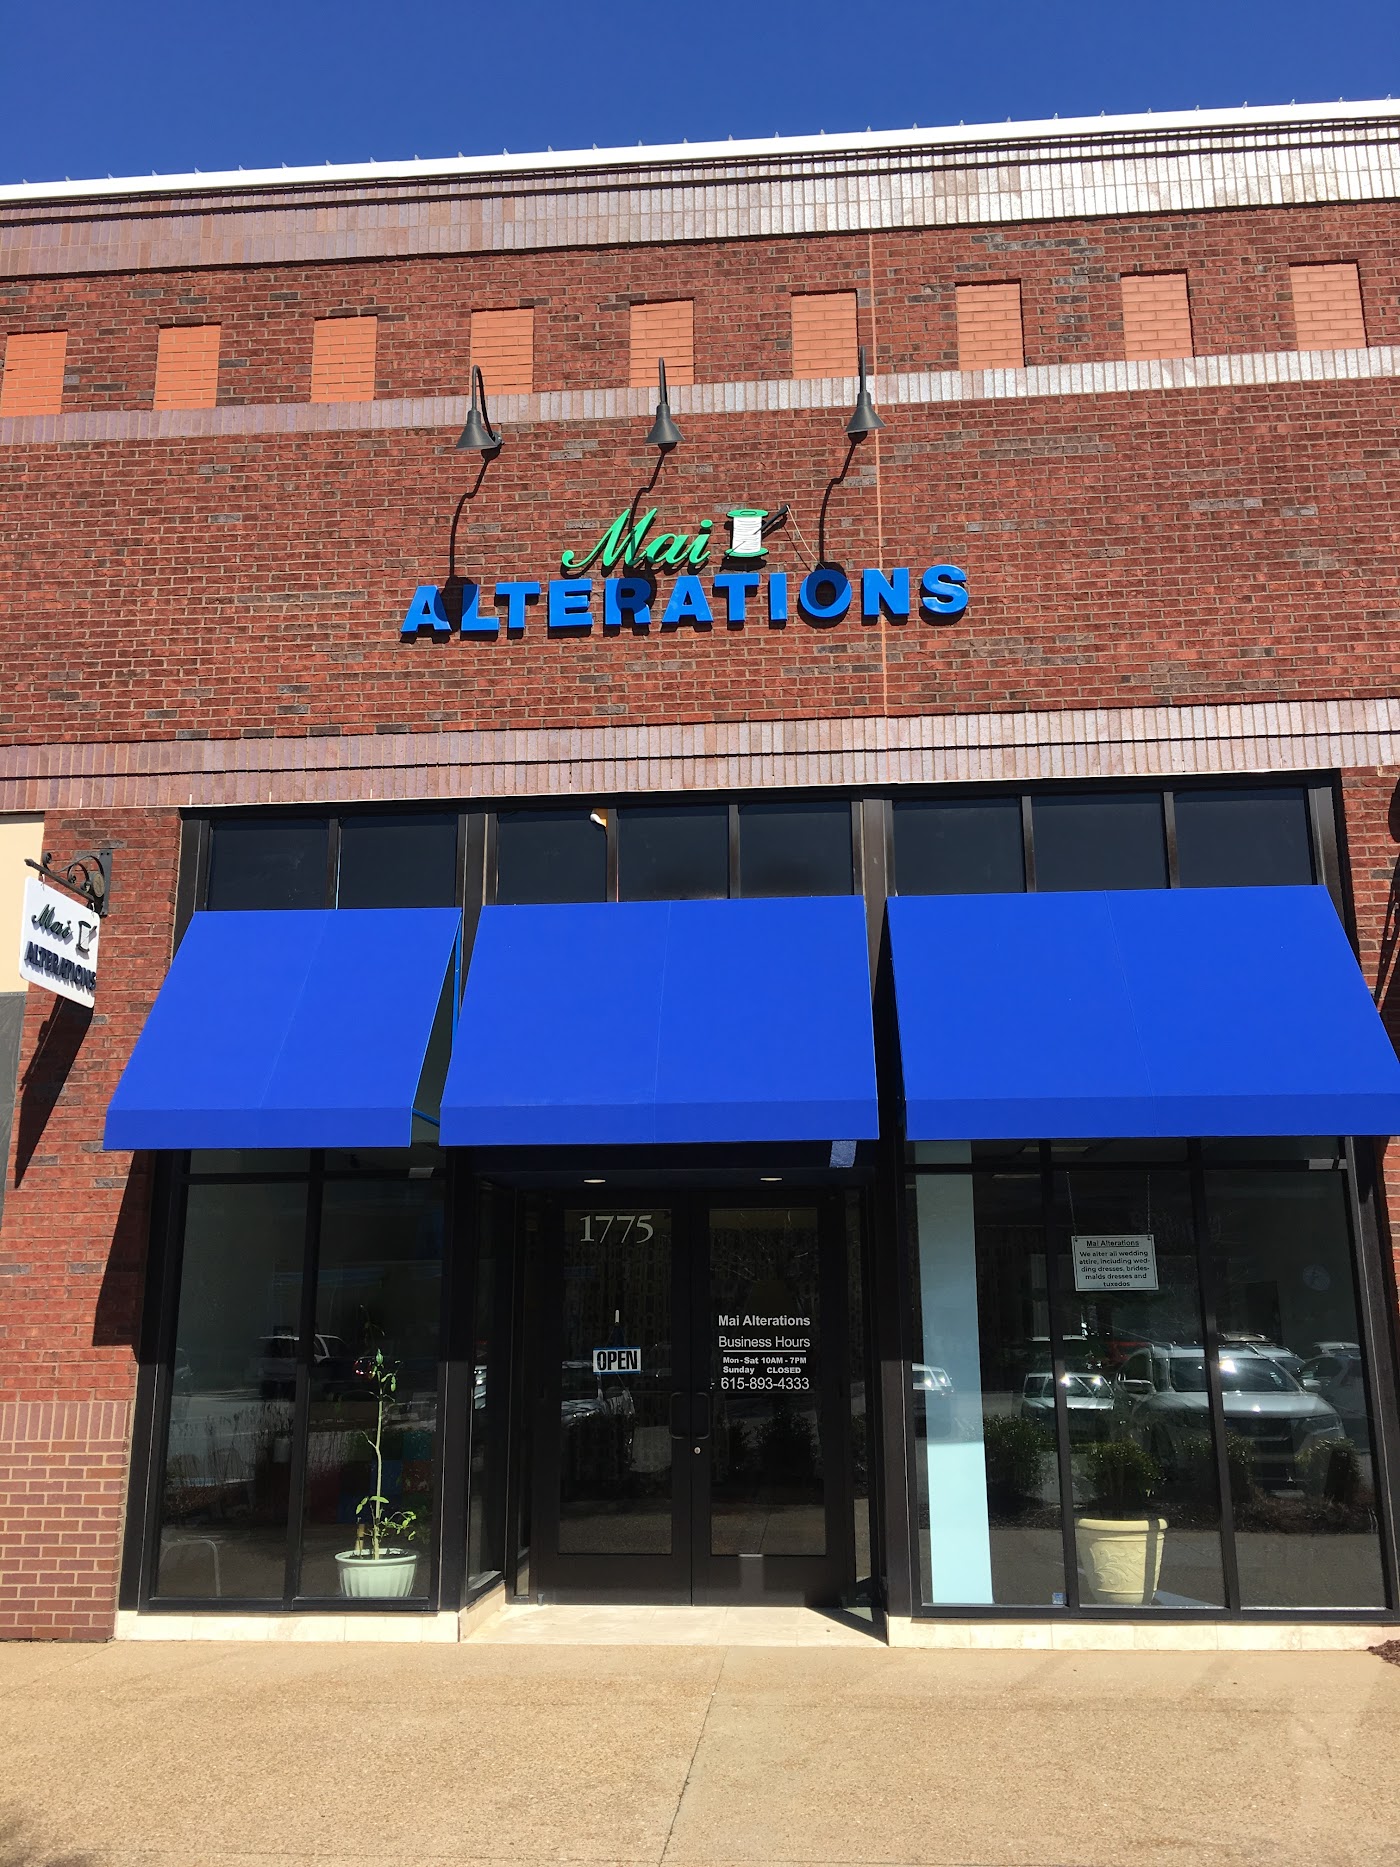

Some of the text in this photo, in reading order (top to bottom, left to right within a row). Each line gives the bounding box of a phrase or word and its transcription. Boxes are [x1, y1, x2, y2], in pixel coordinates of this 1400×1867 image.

[561, 507, 714, 570] Mai
[400, 564, 969, 633] ALTERATIONS
[31, 903, 73, 939] Mai
[24, 941, 97, 991] ALTERATIONS
[579, 1214, 654, 1244] 1775
[1100, 1239, 1140, 1248] Alterations
[1118, 1250, 1149, 1259] wedding
[718, 1314, 811, 1326] Mai Alterations
[718, 1335, 811, 1348] Business Hours
[596, 1350, 638, 1371] OPEN
[760, 1356, 784, 1364] 10AM
[789, 1356, 807, 1364] 7PM
[722, 1365, 802, 1375] Sunday CLOSED
[720, 1376, 810, 1390] 615-893-4333
